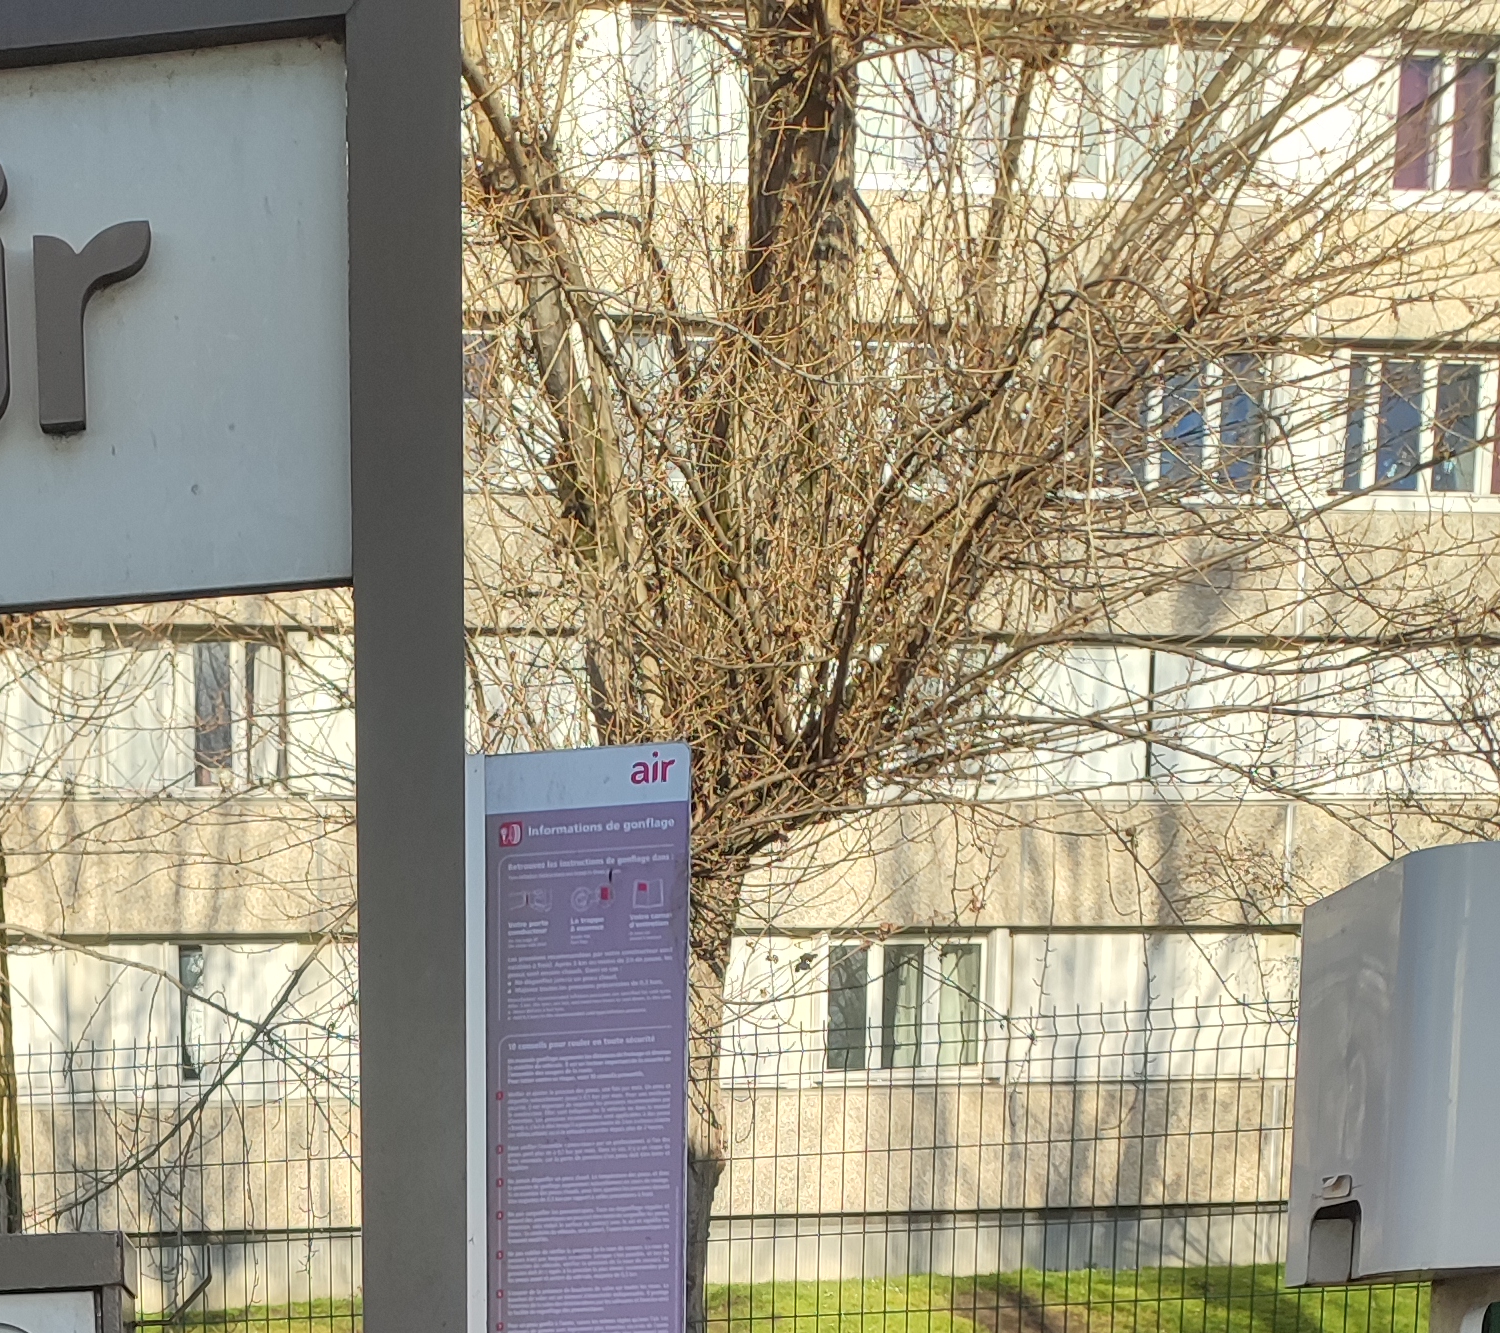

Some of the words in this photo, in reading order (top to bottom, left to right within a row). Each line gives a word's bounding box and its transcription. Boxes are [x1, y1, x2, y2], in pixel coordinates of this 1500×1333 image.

[630, 750, 676, 785] air
[528, 824, 603, 837] Informations
[606, 820, 620, 831] de
[623, 817, 675, 833] gonflage
